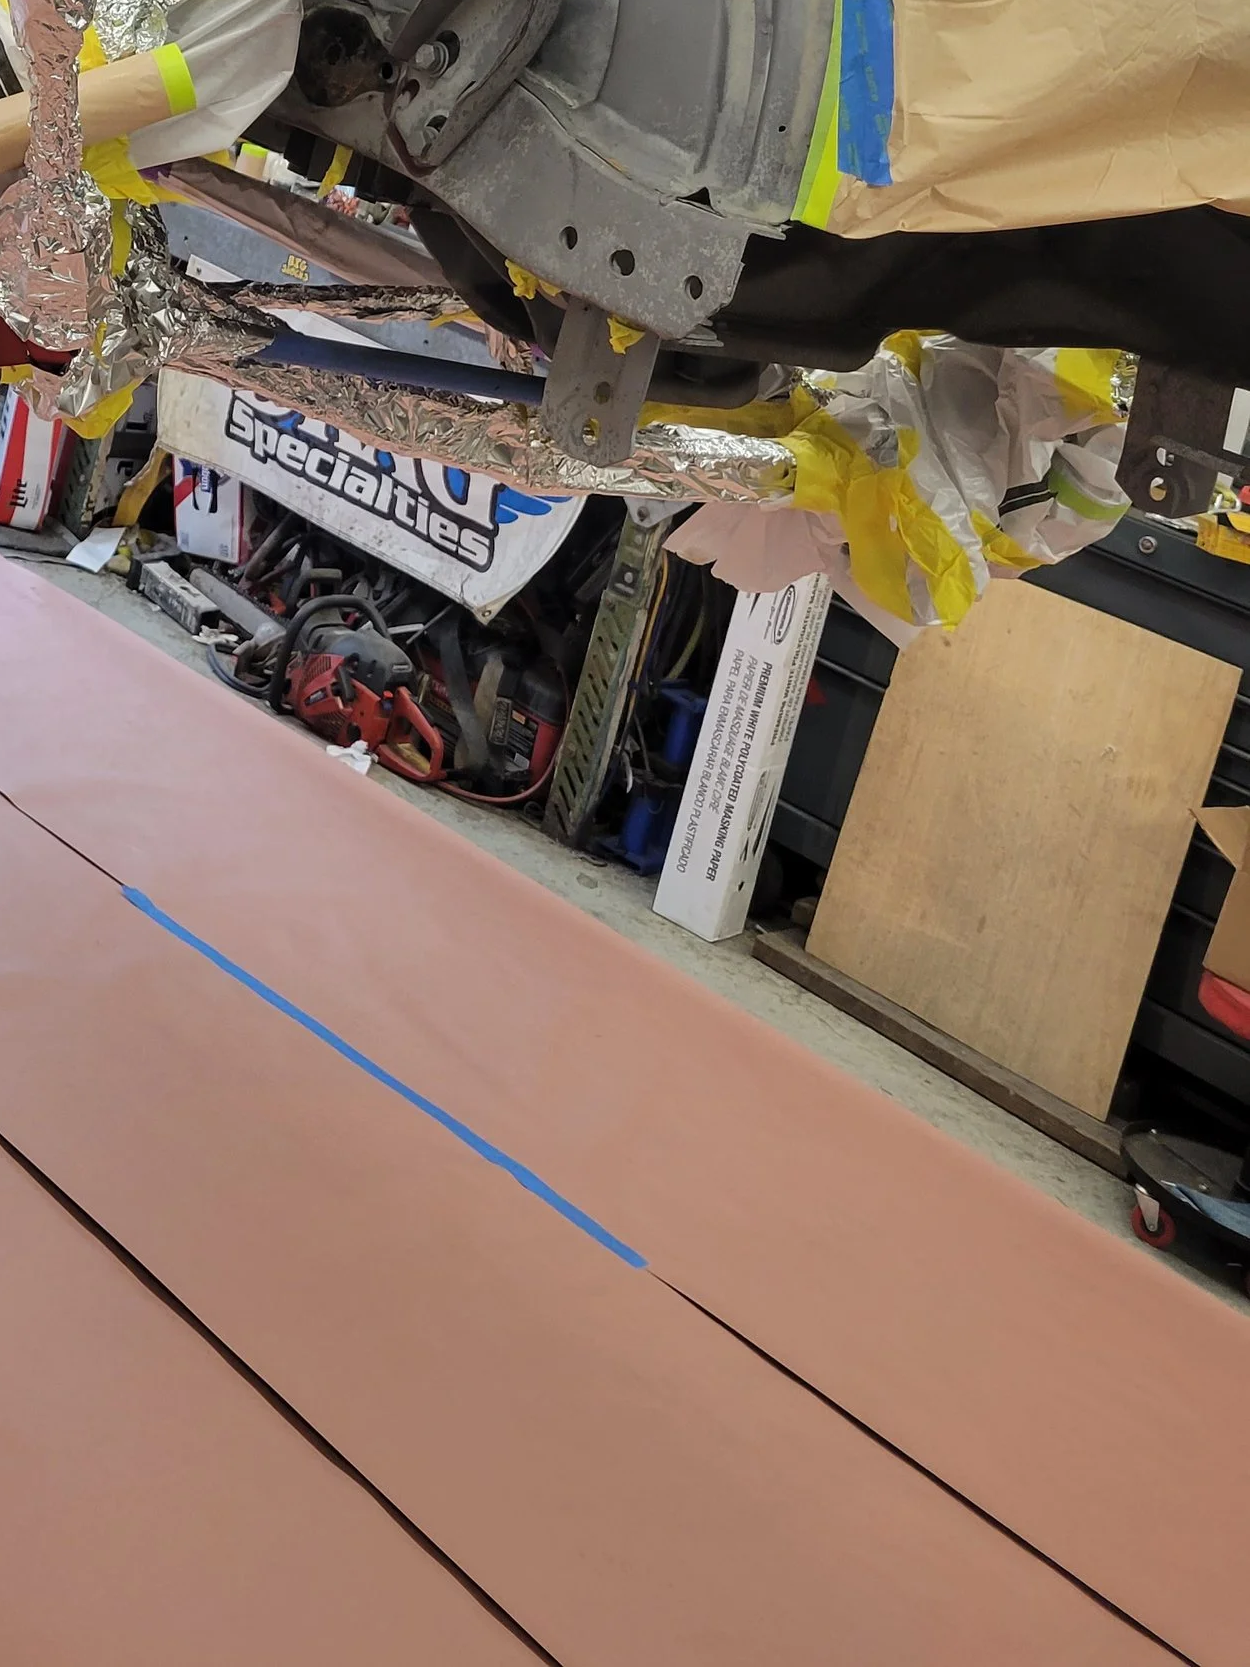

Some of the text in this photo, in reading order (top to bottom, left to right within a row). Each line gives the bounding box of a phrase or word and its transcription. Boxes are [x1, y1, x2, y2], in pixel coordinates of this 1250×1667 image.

[9, 478, 28, 508] Lite
[227, 398, 493, 571] Specialties
[742, 655, 758, 692] PAPIER
[753, 661, 773, 709] PREMIUM
[737, 690, 749, 706] DE
[723, 704, 745, 759] MASQUAGE
[744, 710, 760, 742] WHITE
[676, 648, 744, 874] PAPEL PARA ENMASCARAR BLANCO PLASTIFICADO
[714, 757, 731, 791] BLANC
[727, 741, 751, 802] POLYCOATED
[715, 802, 735, 849] MASKING
[706, 848, 722, 882] PAPER
